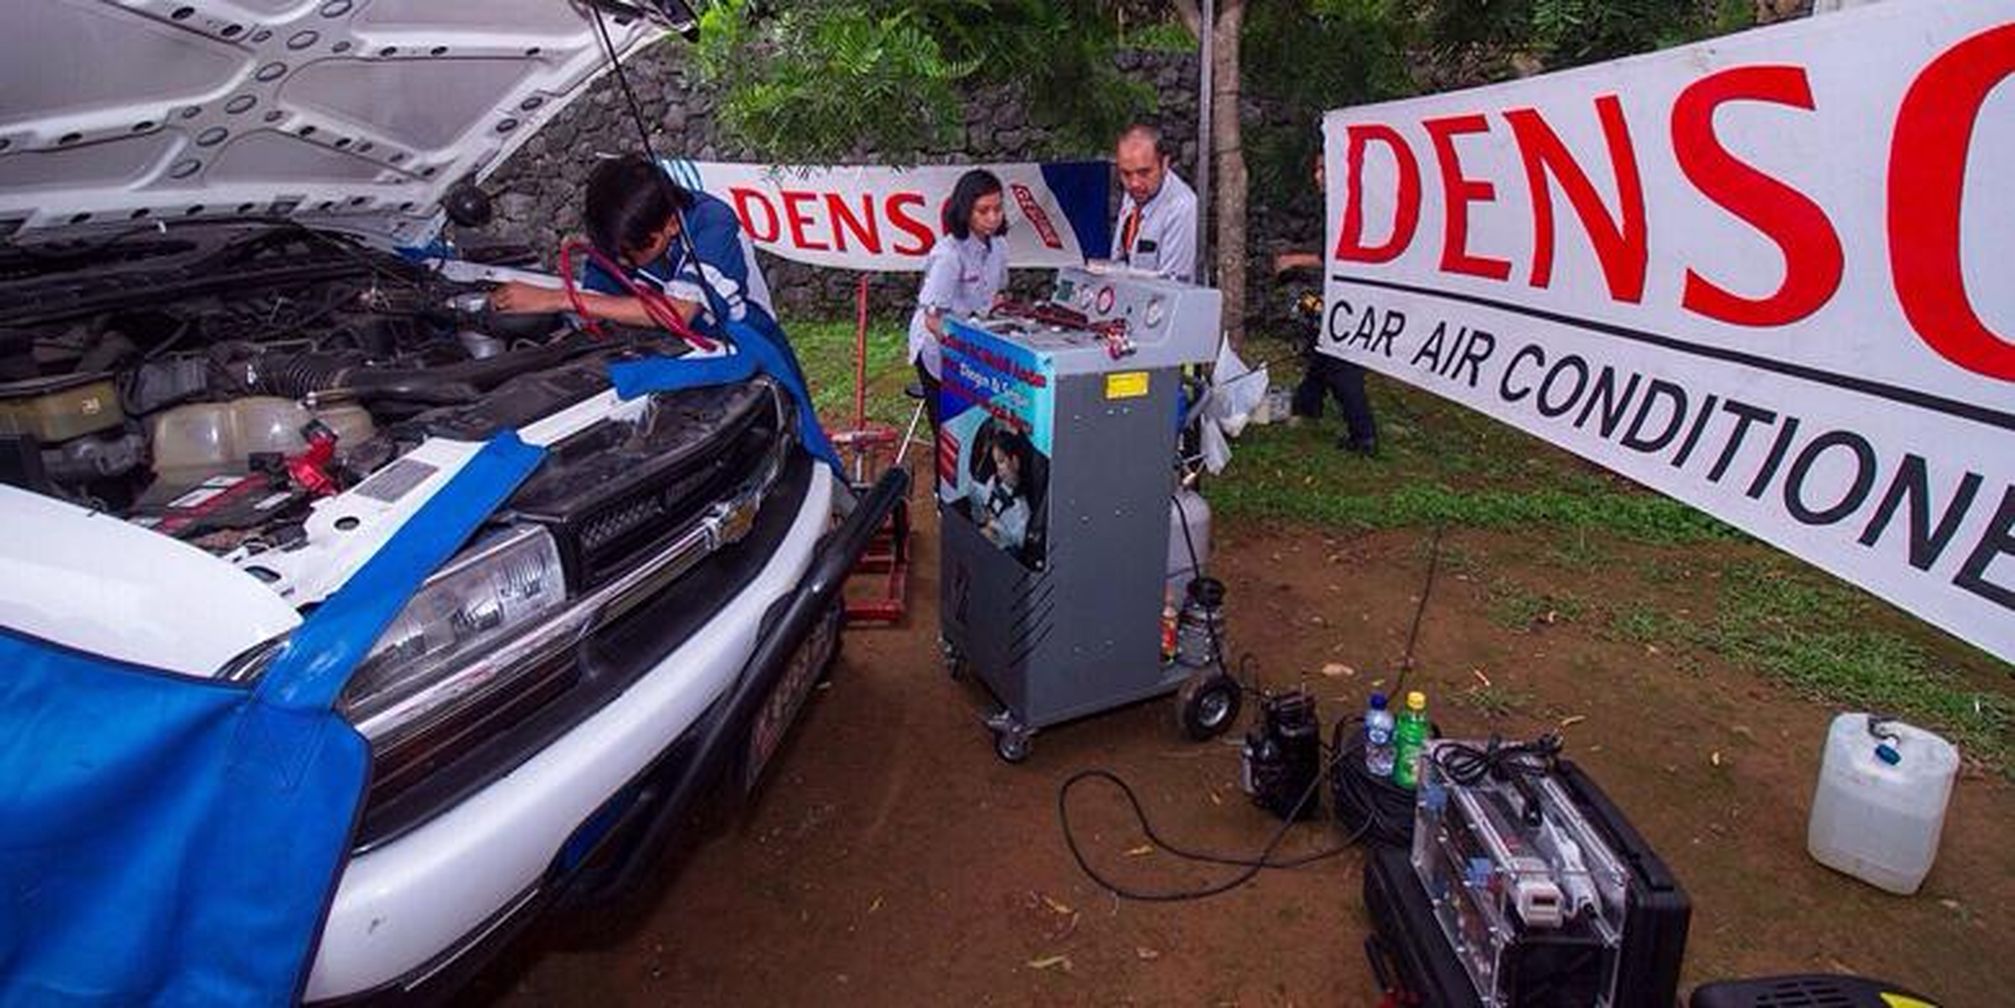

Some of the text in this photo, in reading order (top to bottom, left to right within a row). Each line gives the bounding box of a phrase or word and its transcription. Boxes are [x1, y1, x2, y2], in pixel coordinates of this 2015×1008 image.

[729, 187, 951, 257] DENS
[1328, 299, 1406, 358] CAR
[1410, 321, 1496, 388] AIR
